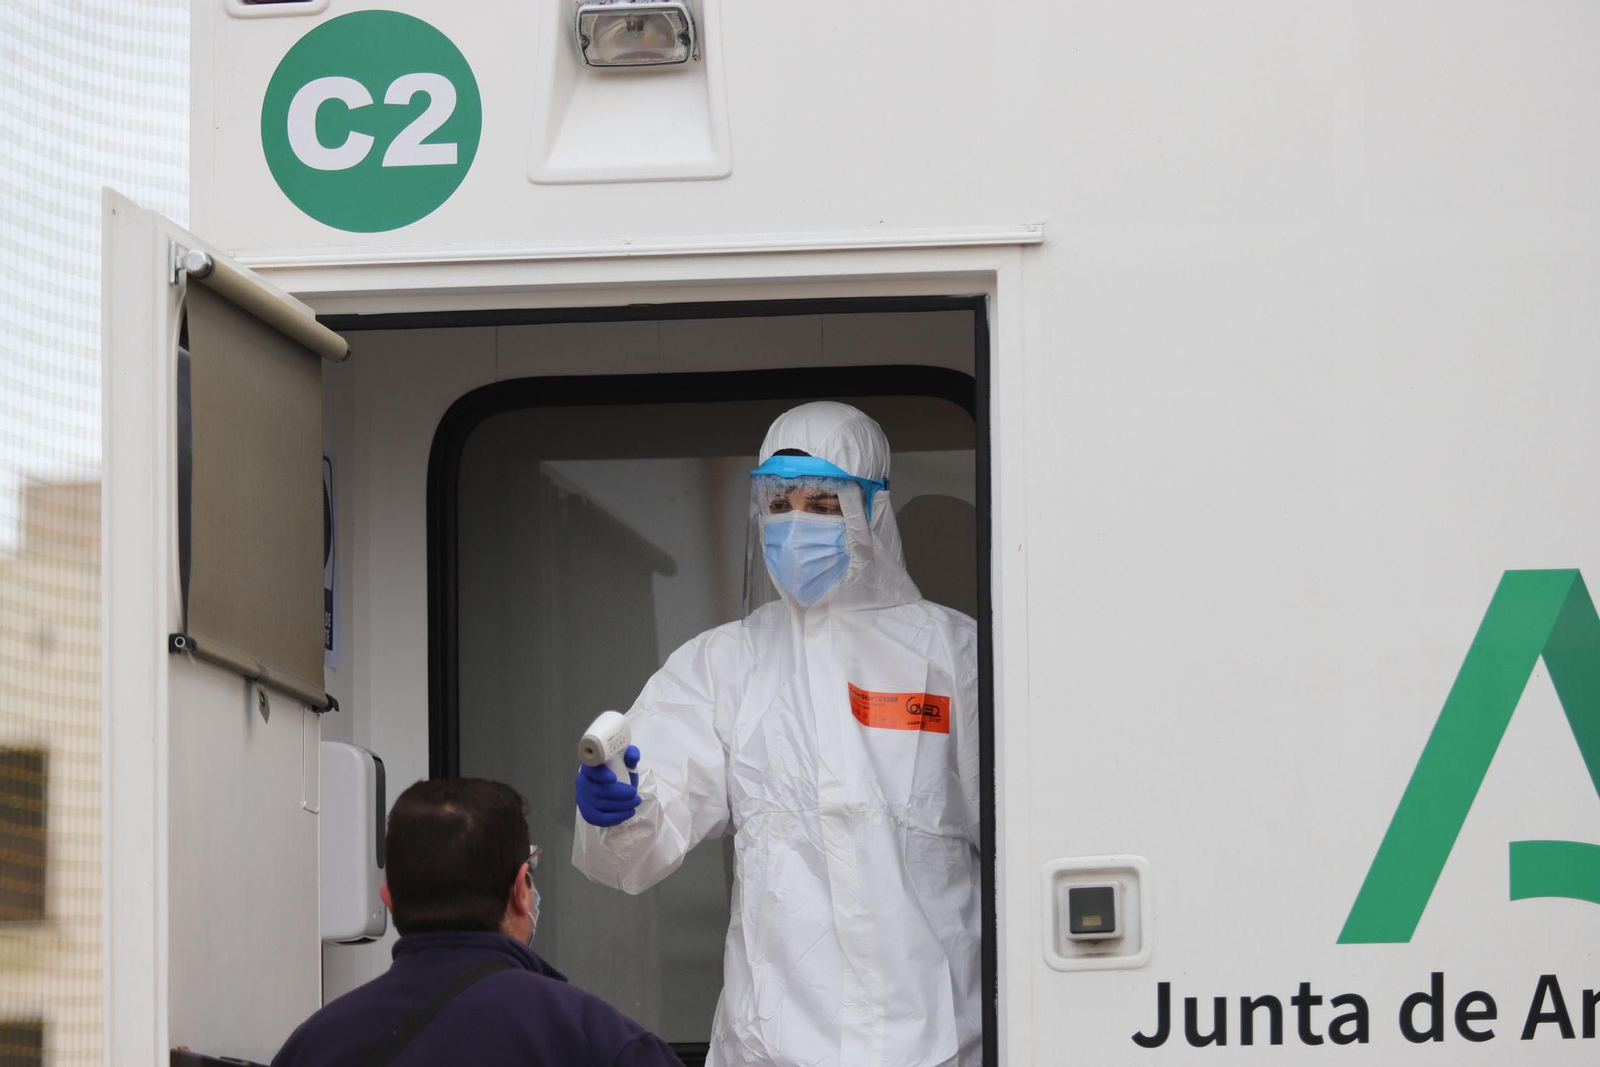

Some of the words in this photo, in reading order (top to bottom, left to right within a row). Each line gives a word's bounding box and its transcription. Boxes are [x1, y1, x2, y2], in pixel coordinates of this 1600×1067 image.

[287, 72, 458, 171] C2
[1131, 981, 1370, 1048] Junta
[1399, 972, 1498, 1043] de
